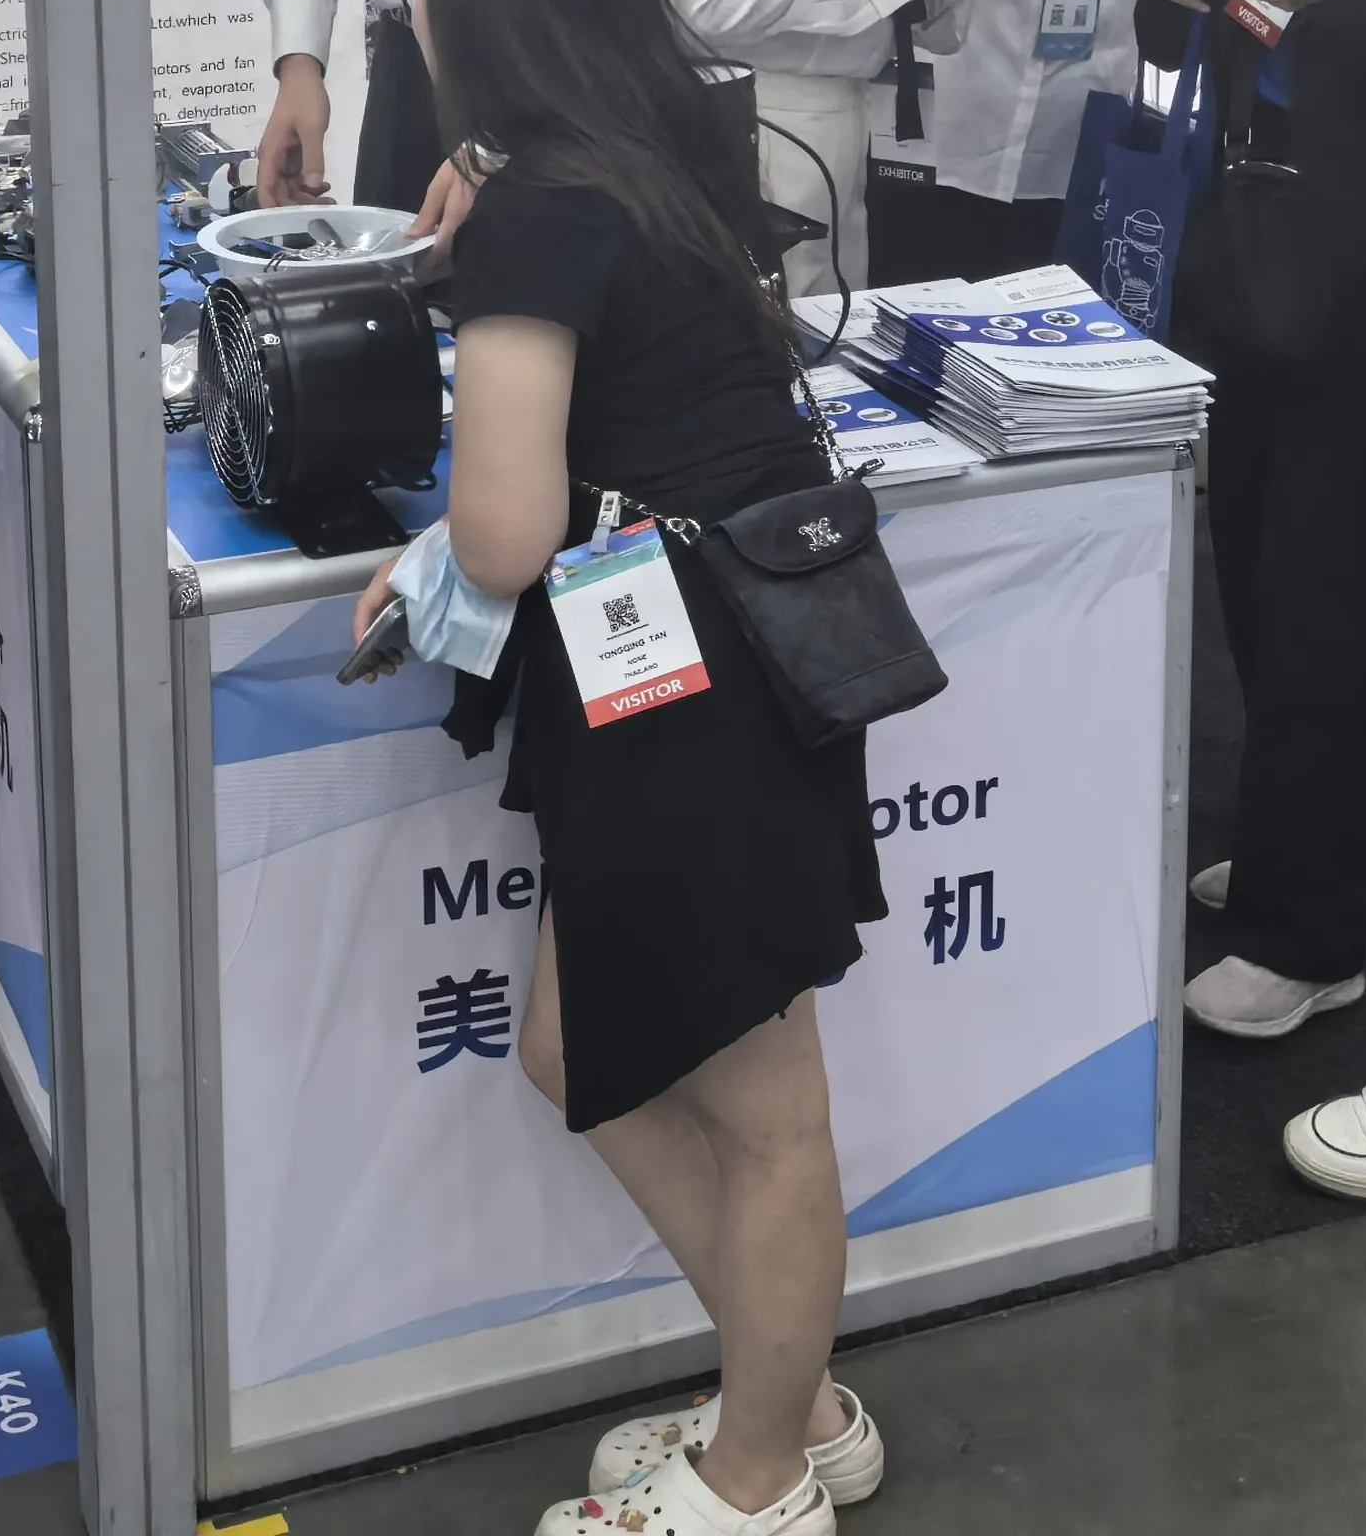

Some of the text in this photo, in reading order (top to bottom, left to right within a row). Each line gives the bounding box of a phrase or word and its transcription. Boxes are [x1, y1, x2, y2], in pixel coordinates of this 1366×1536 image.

[228, 13, 253, 24] was
[1238, 6, 1270, 37] VISITOR
[200, 59, 225, 72] and
[234, 57, 255, 70] fan
[178, 104, 256, 121] dehydration
[611, 679, 684, 712] VISITOR
[871, 775, 1000, 839] otor
[417, 870, 1005, 1073] 美 机
